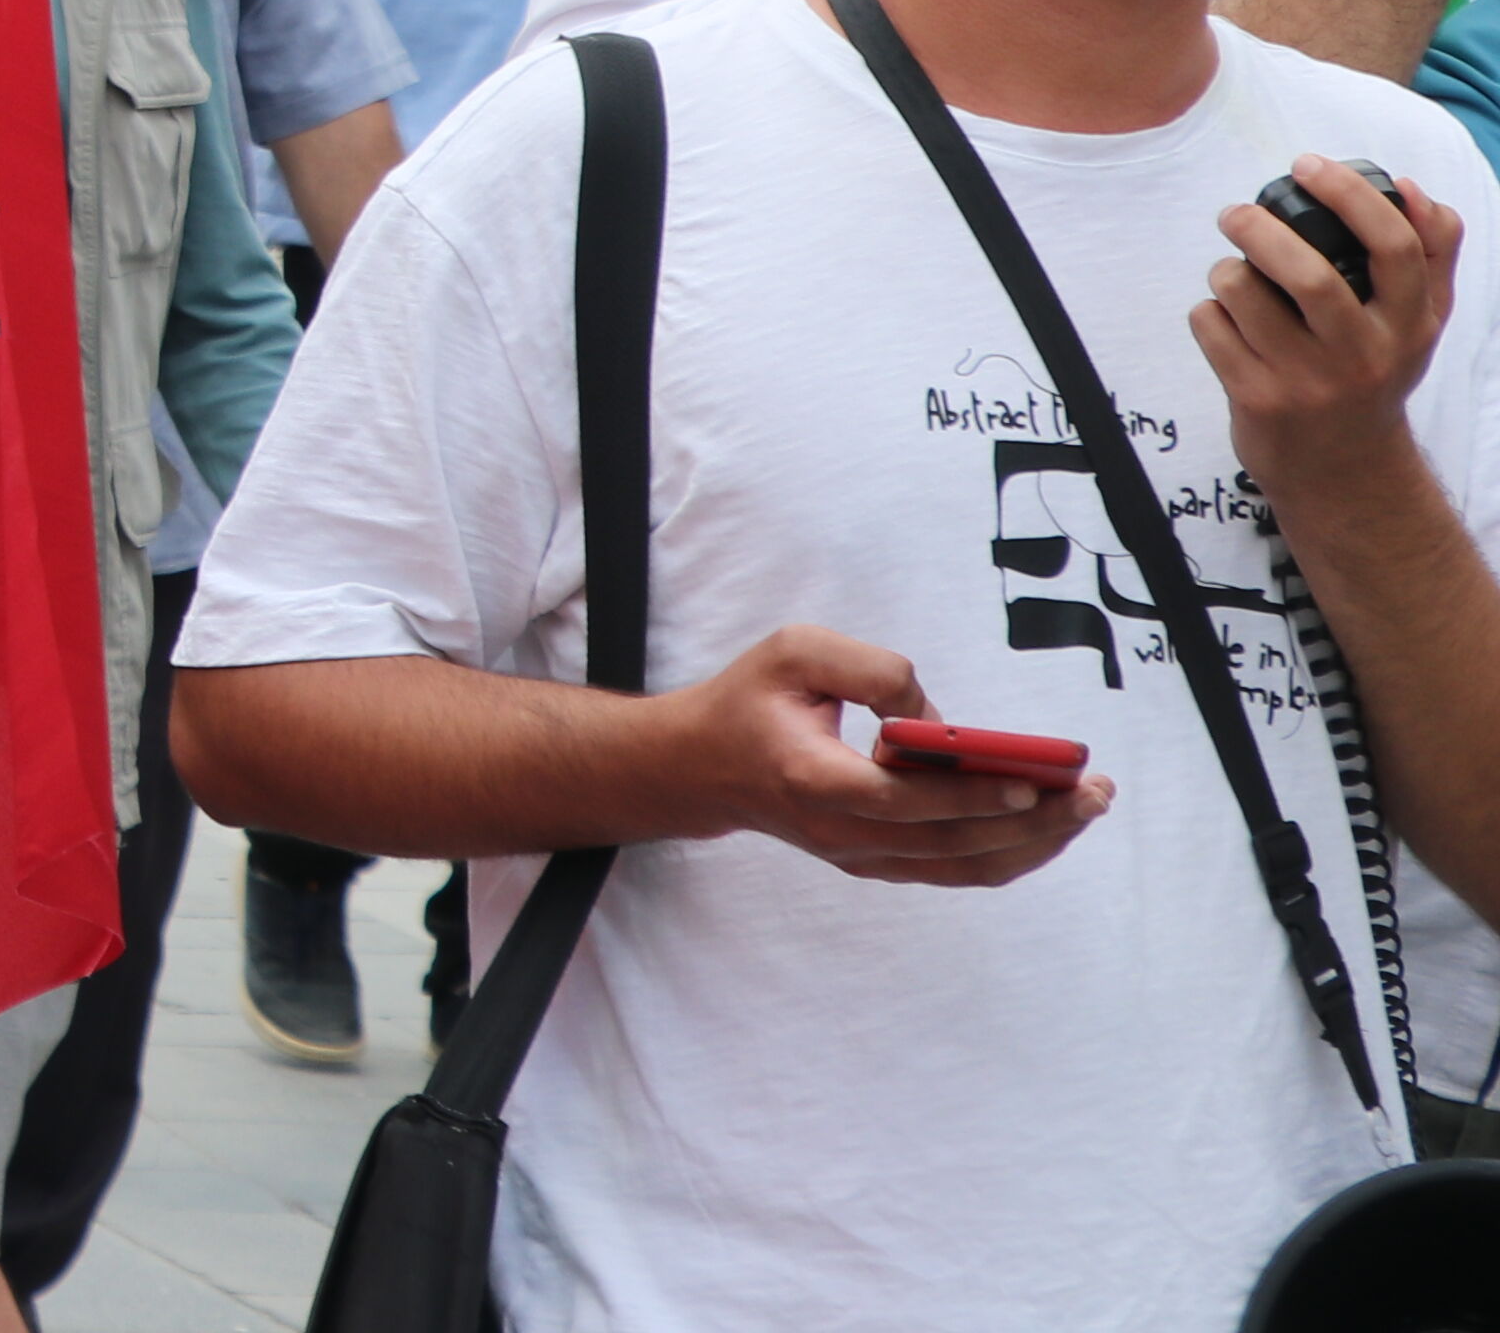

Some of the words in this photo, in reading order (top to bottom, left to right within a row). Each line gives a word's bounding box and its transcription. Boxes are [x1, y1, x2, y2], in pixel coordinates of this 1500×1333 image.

[925, 387, 1043, 437] Abstract
[1052, 391, 1179, 452] thing
[1259, 642, 1288, 670] in
[1236, 667, 1318, 726] mplex
